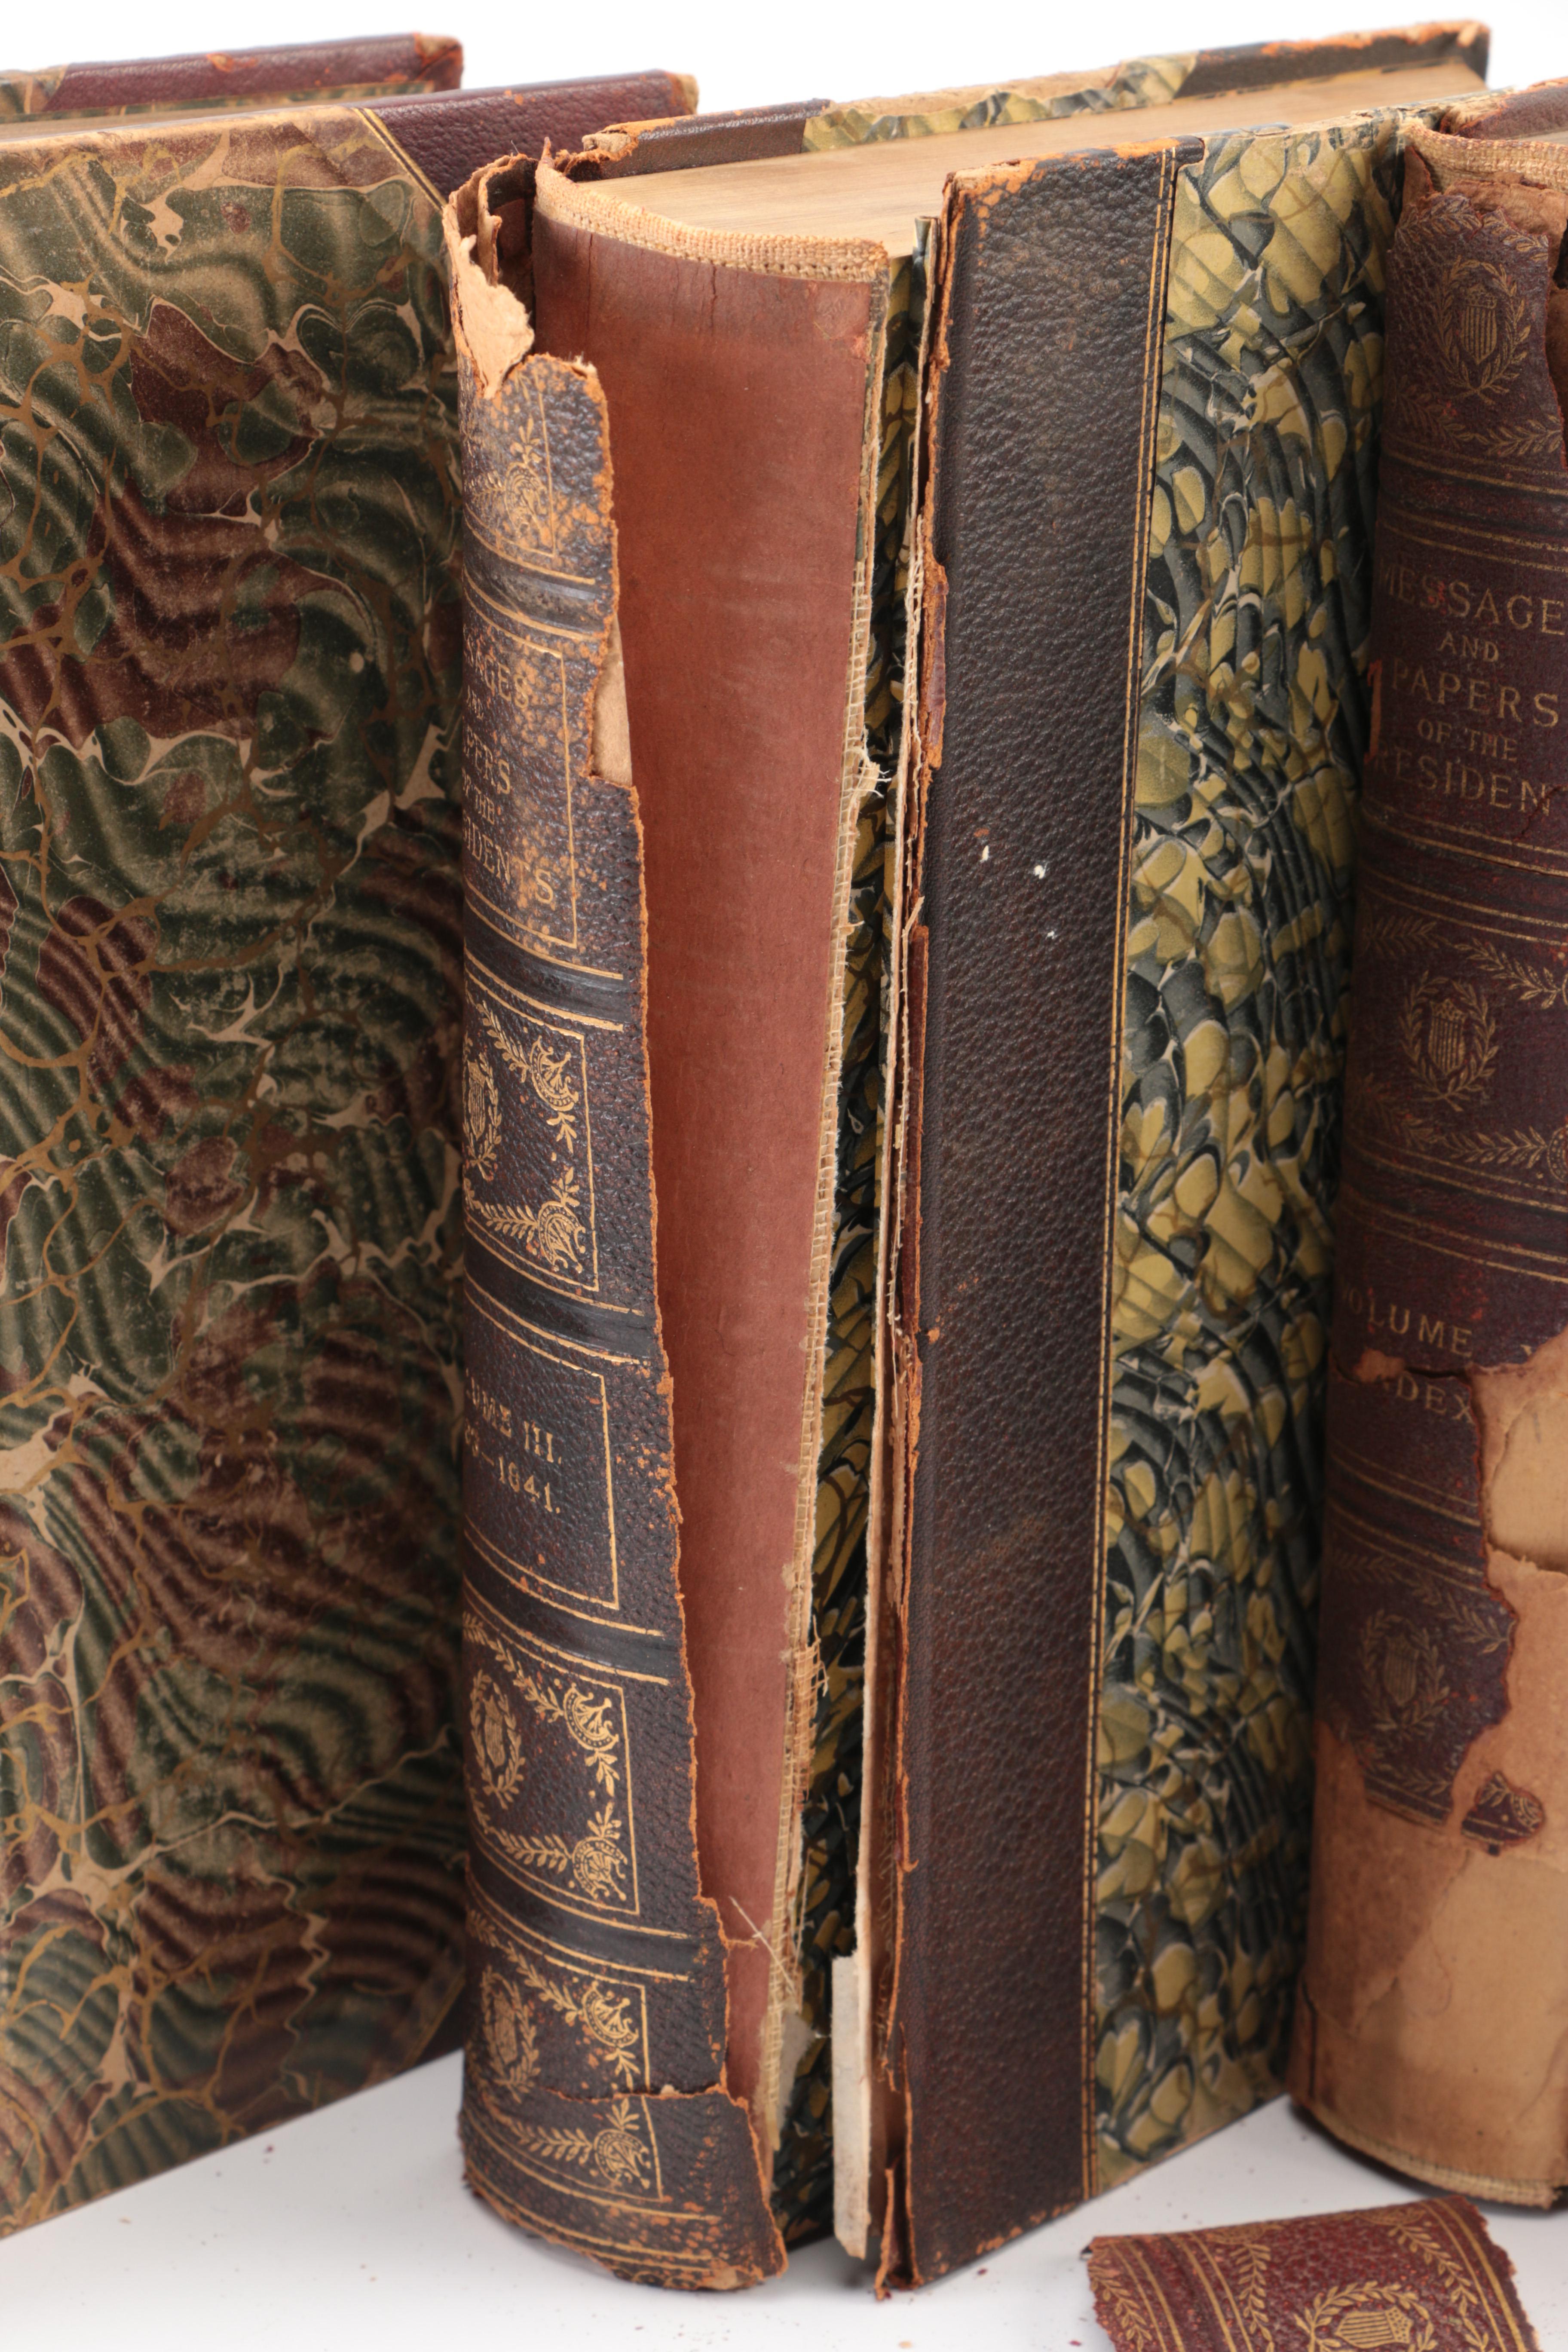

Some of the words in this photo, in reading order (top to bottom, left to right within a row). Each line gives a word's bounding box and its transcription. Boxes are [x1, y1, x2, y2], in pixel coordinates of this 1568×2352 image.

[1437, 631, 1499, 663] AND
[1391, 656, 1559, 727] PAPERS
[1418, 718, 1452, 744] OF
[1464, 727, 1518, 763] THE
